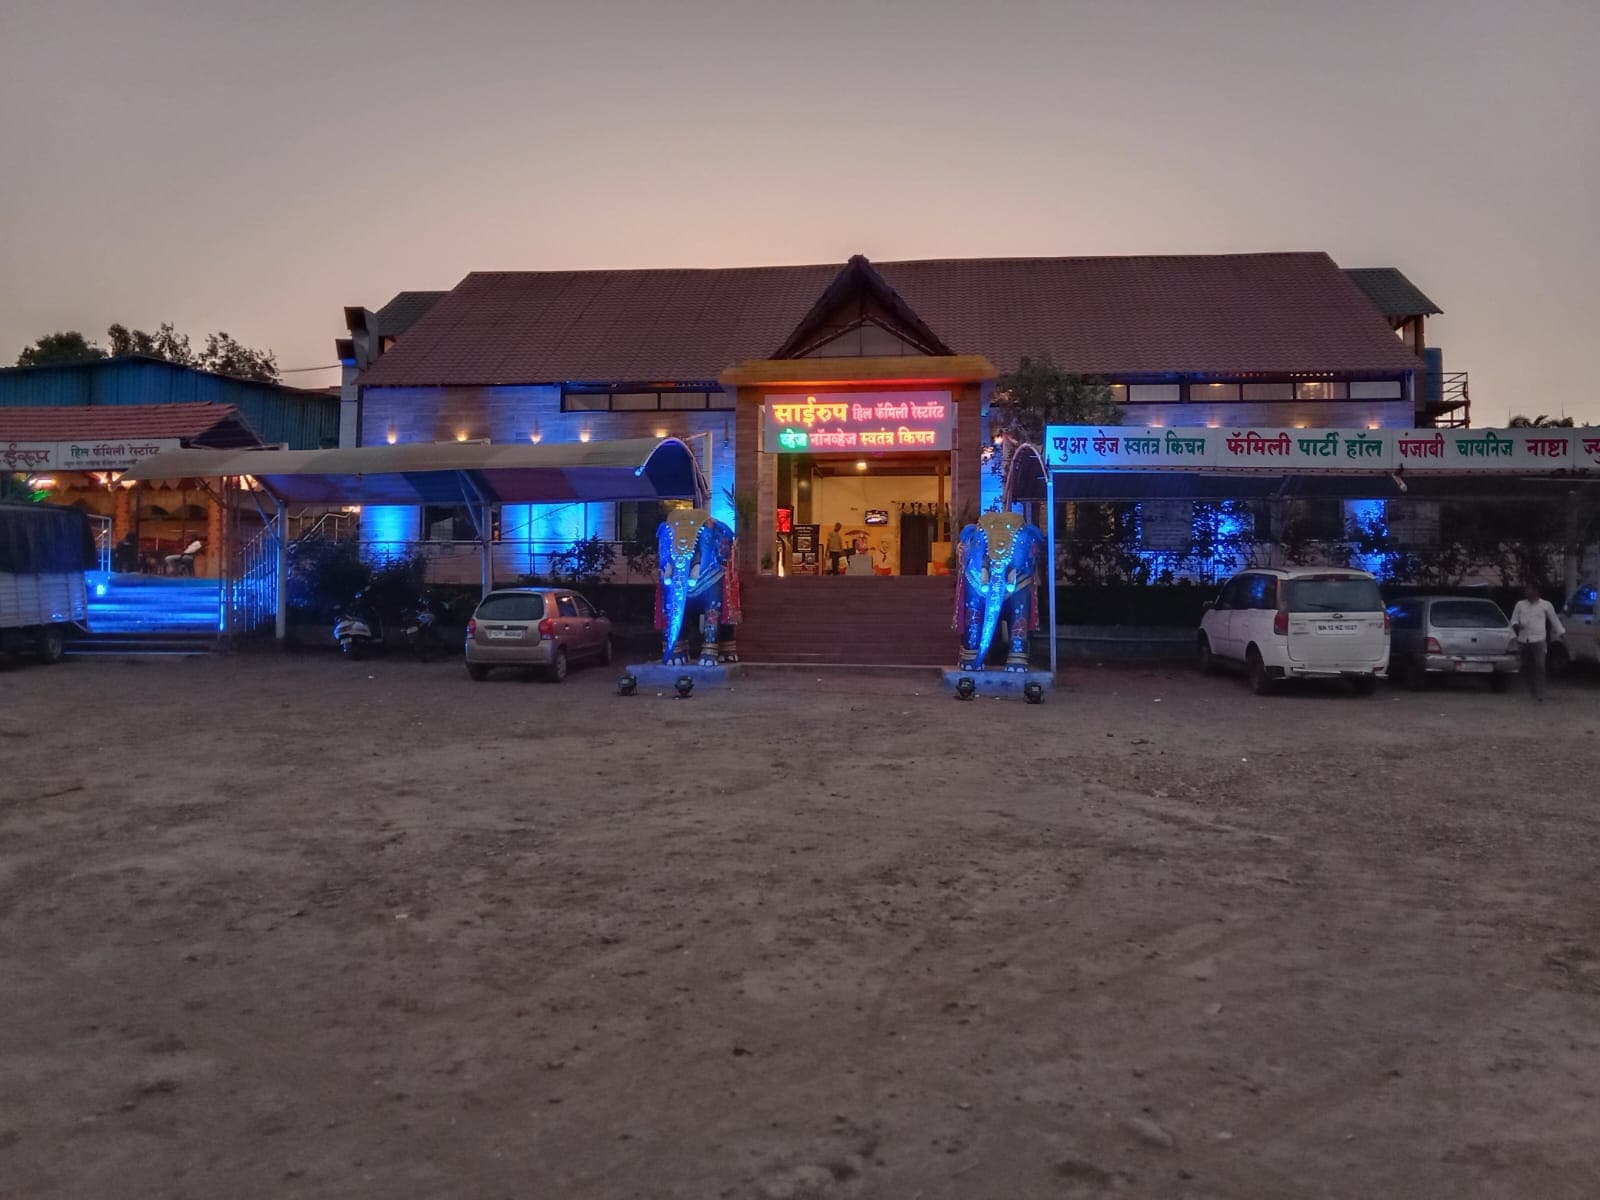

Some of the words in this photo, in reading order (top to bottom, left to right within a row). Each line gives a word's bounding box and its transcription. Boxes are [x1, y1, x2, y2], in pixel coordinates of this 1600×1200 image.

[852, 403, 872, 421] हिल
[874, 402, 908, 419] फॅमिली
[779, 428, 808, 448] व्हेज
[809, 427, 857, 447] नॉनव्हेज
[859, 427, 894, 445] स्वतंत्र
[897, 426, 936, 444] किचन
[1053, 436, 1088, 462] प्युअर
[1092, 429, 1120, 457] व्हेज
[1124, 430, 1160, 456] स्वतंत्र
[1165, 430, 1205, 455] किचन
[1226, 432, 1291, 456] फॅमिली
[1298, 432, 1339, 457] पार्टी
[1344, 434, 1383, 459] हॉल
[1399, 432, 1445, 459] पंजाबी
[1456, 431, 1513, 458] चायनिज
[1525, 438, 1568, 458] नाष्टा
[71, 445, 89, 457] हिल
